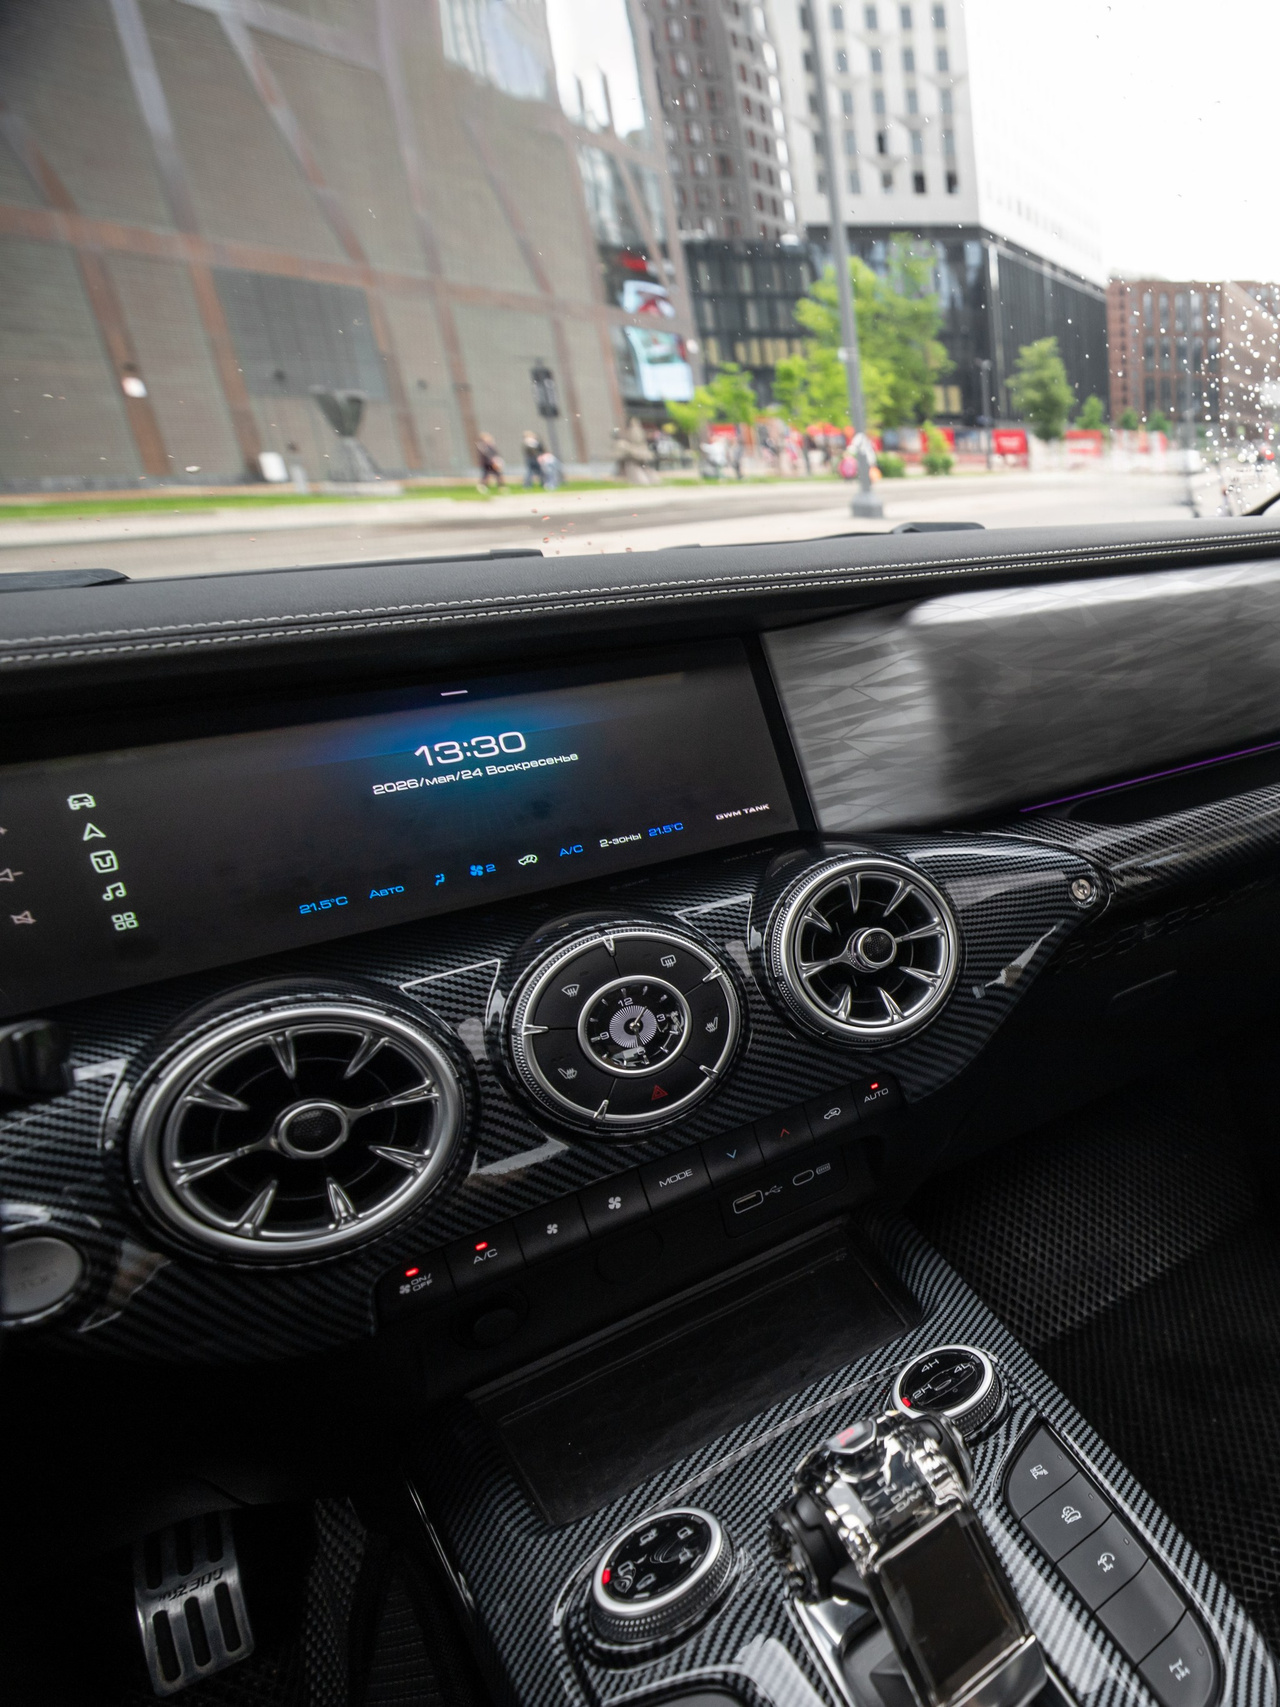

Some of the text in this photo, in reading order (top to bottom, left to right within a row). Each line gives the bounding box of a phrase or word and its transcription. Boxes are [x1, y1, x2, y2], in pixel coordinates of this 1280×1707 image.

[414, 731, 526, 766] 13:30
[372, 753, 579, 795] 2026/мая/24 Воскресенье
[715, 803, 770, 821] GWM TANK
[599, 833, 642, 848] 2-зоны
[559, 844, 584, 857] A/C
[486, 863, 496, 873] 2
[299, 896, 348, 914] 21.5°C
[618, 997, 633, 1007] 12
[656, 1013, 666, 1022] 3
[600, 1031, 610, 1040] 9
[863, 1088, 889, 1103] AUTO
[659, 1168, 693, 1188] MODE
[473, 1248, 498, 1264] A/C
[412, 1279, 433, 1292] OFF
[921, 1358, 940, 1373] 4H
[953, 1363, 971, 1374] 4L
[912, 1383, 933, 1399] 2H
